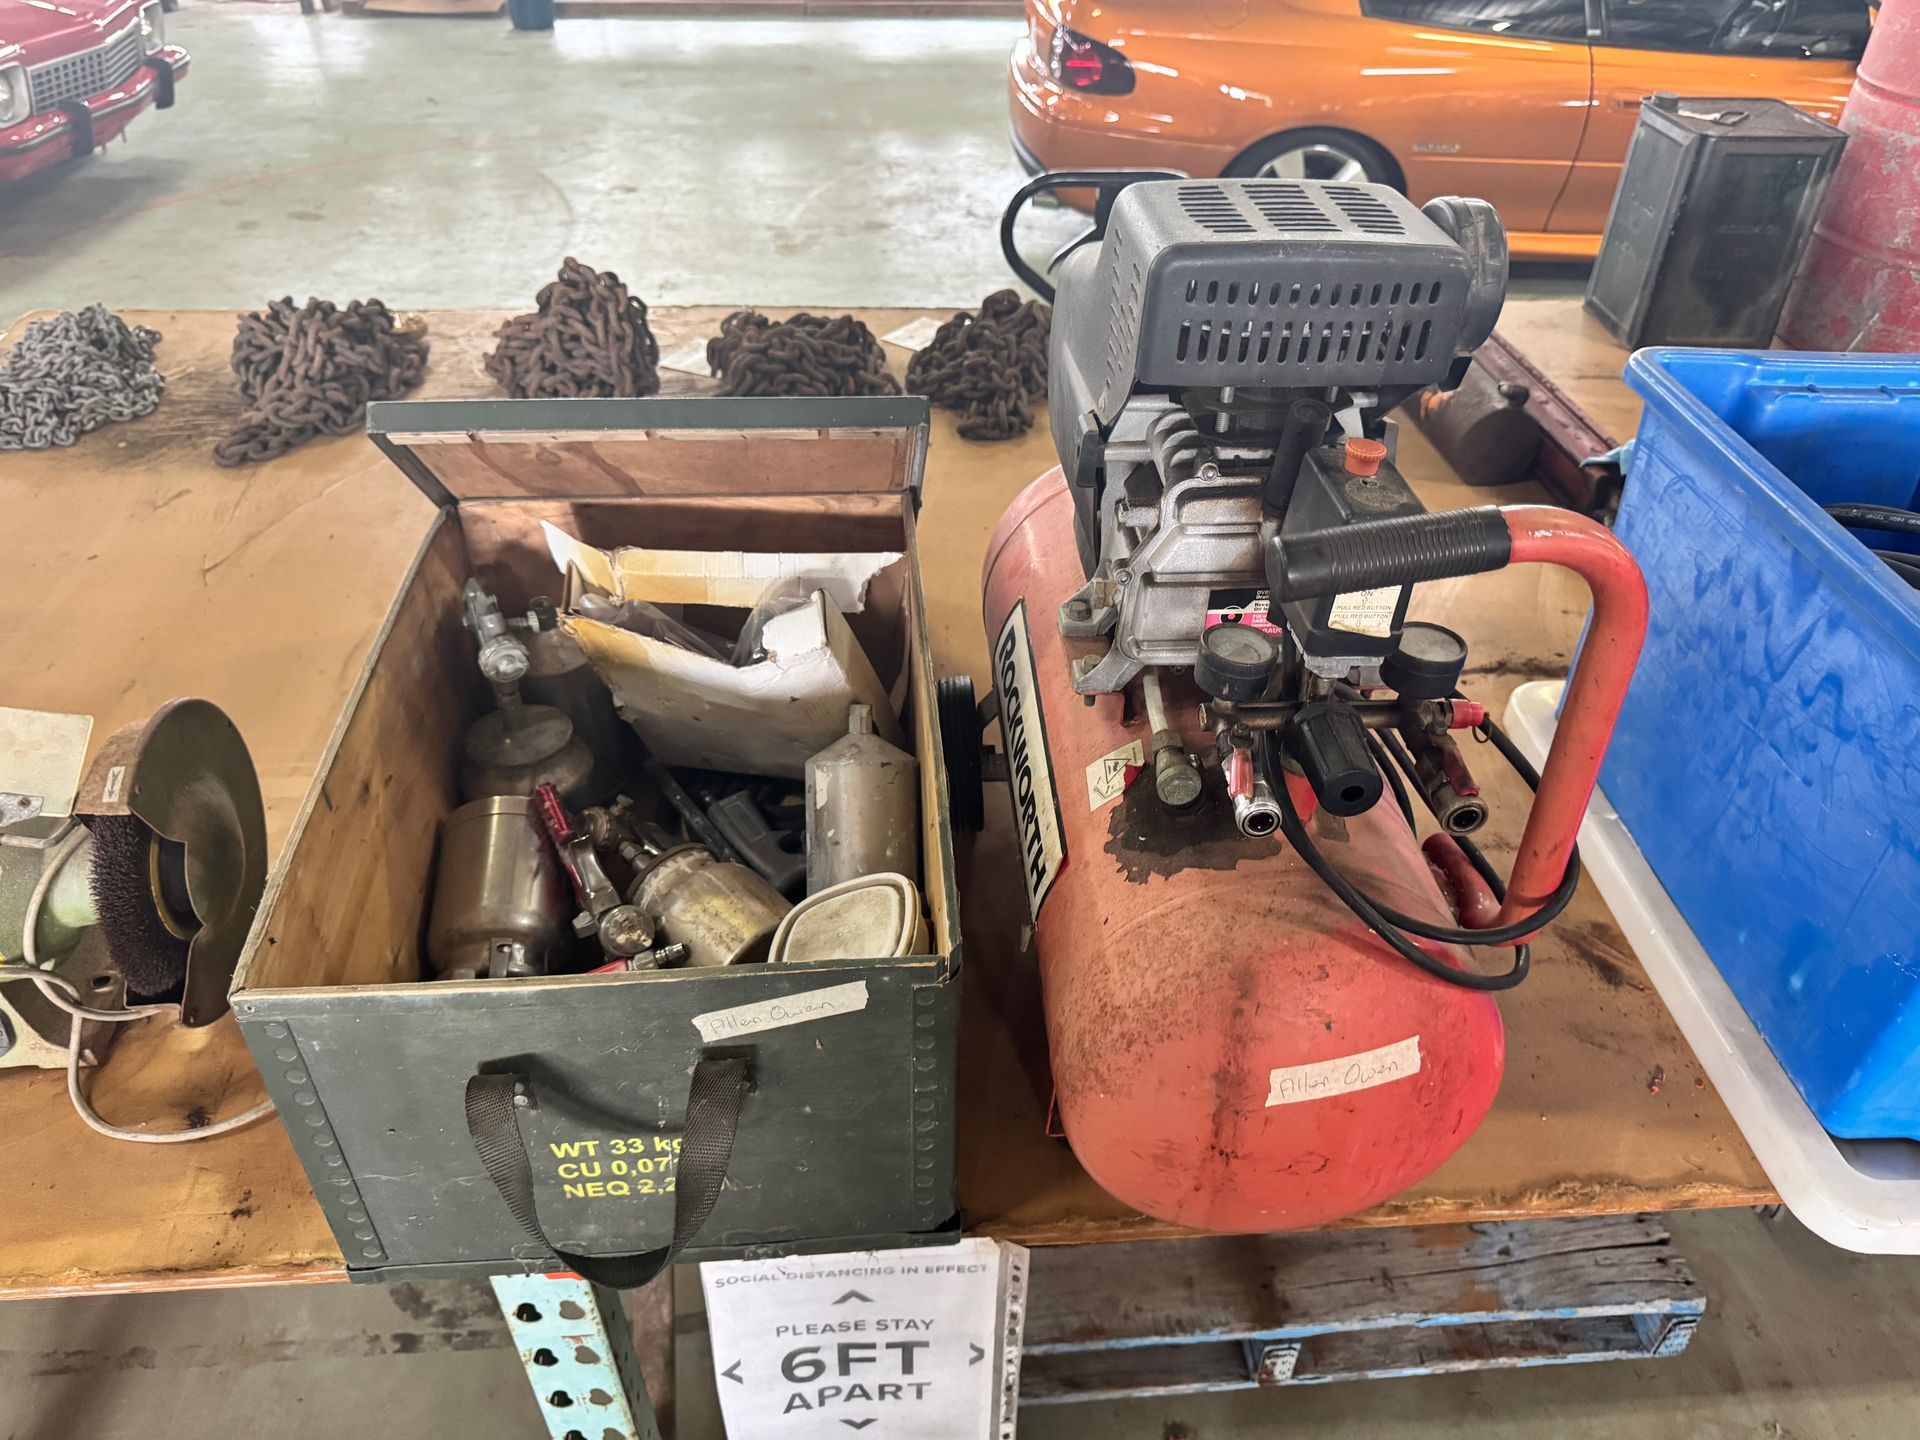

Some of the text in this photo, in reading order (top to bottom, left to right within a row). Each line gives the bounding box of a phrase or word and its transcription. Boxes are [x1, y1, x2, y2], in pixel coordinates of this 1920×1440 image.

[1000, 624, 1047, 899] ROCKWORTH
[710, 1002, 835, 1035] Allen Owen
[1279, 1060, 1398, 1099] Allen Owen
[550, 1140, 600, 1159] WT
[609, 1138, 645, 1155] 33
[558, 1161, 602, 1179] CU
[563, 1180, 631, 1199] NEQ
[715, 1263, 989, 1289] SOCIAL DISTANCING IN EFFECT
[776, 1318, 935, 1338] PLEASE STAY
[780, 1340, 931, 1384] 6FT
[782, 1381, 932, 1415] APART
